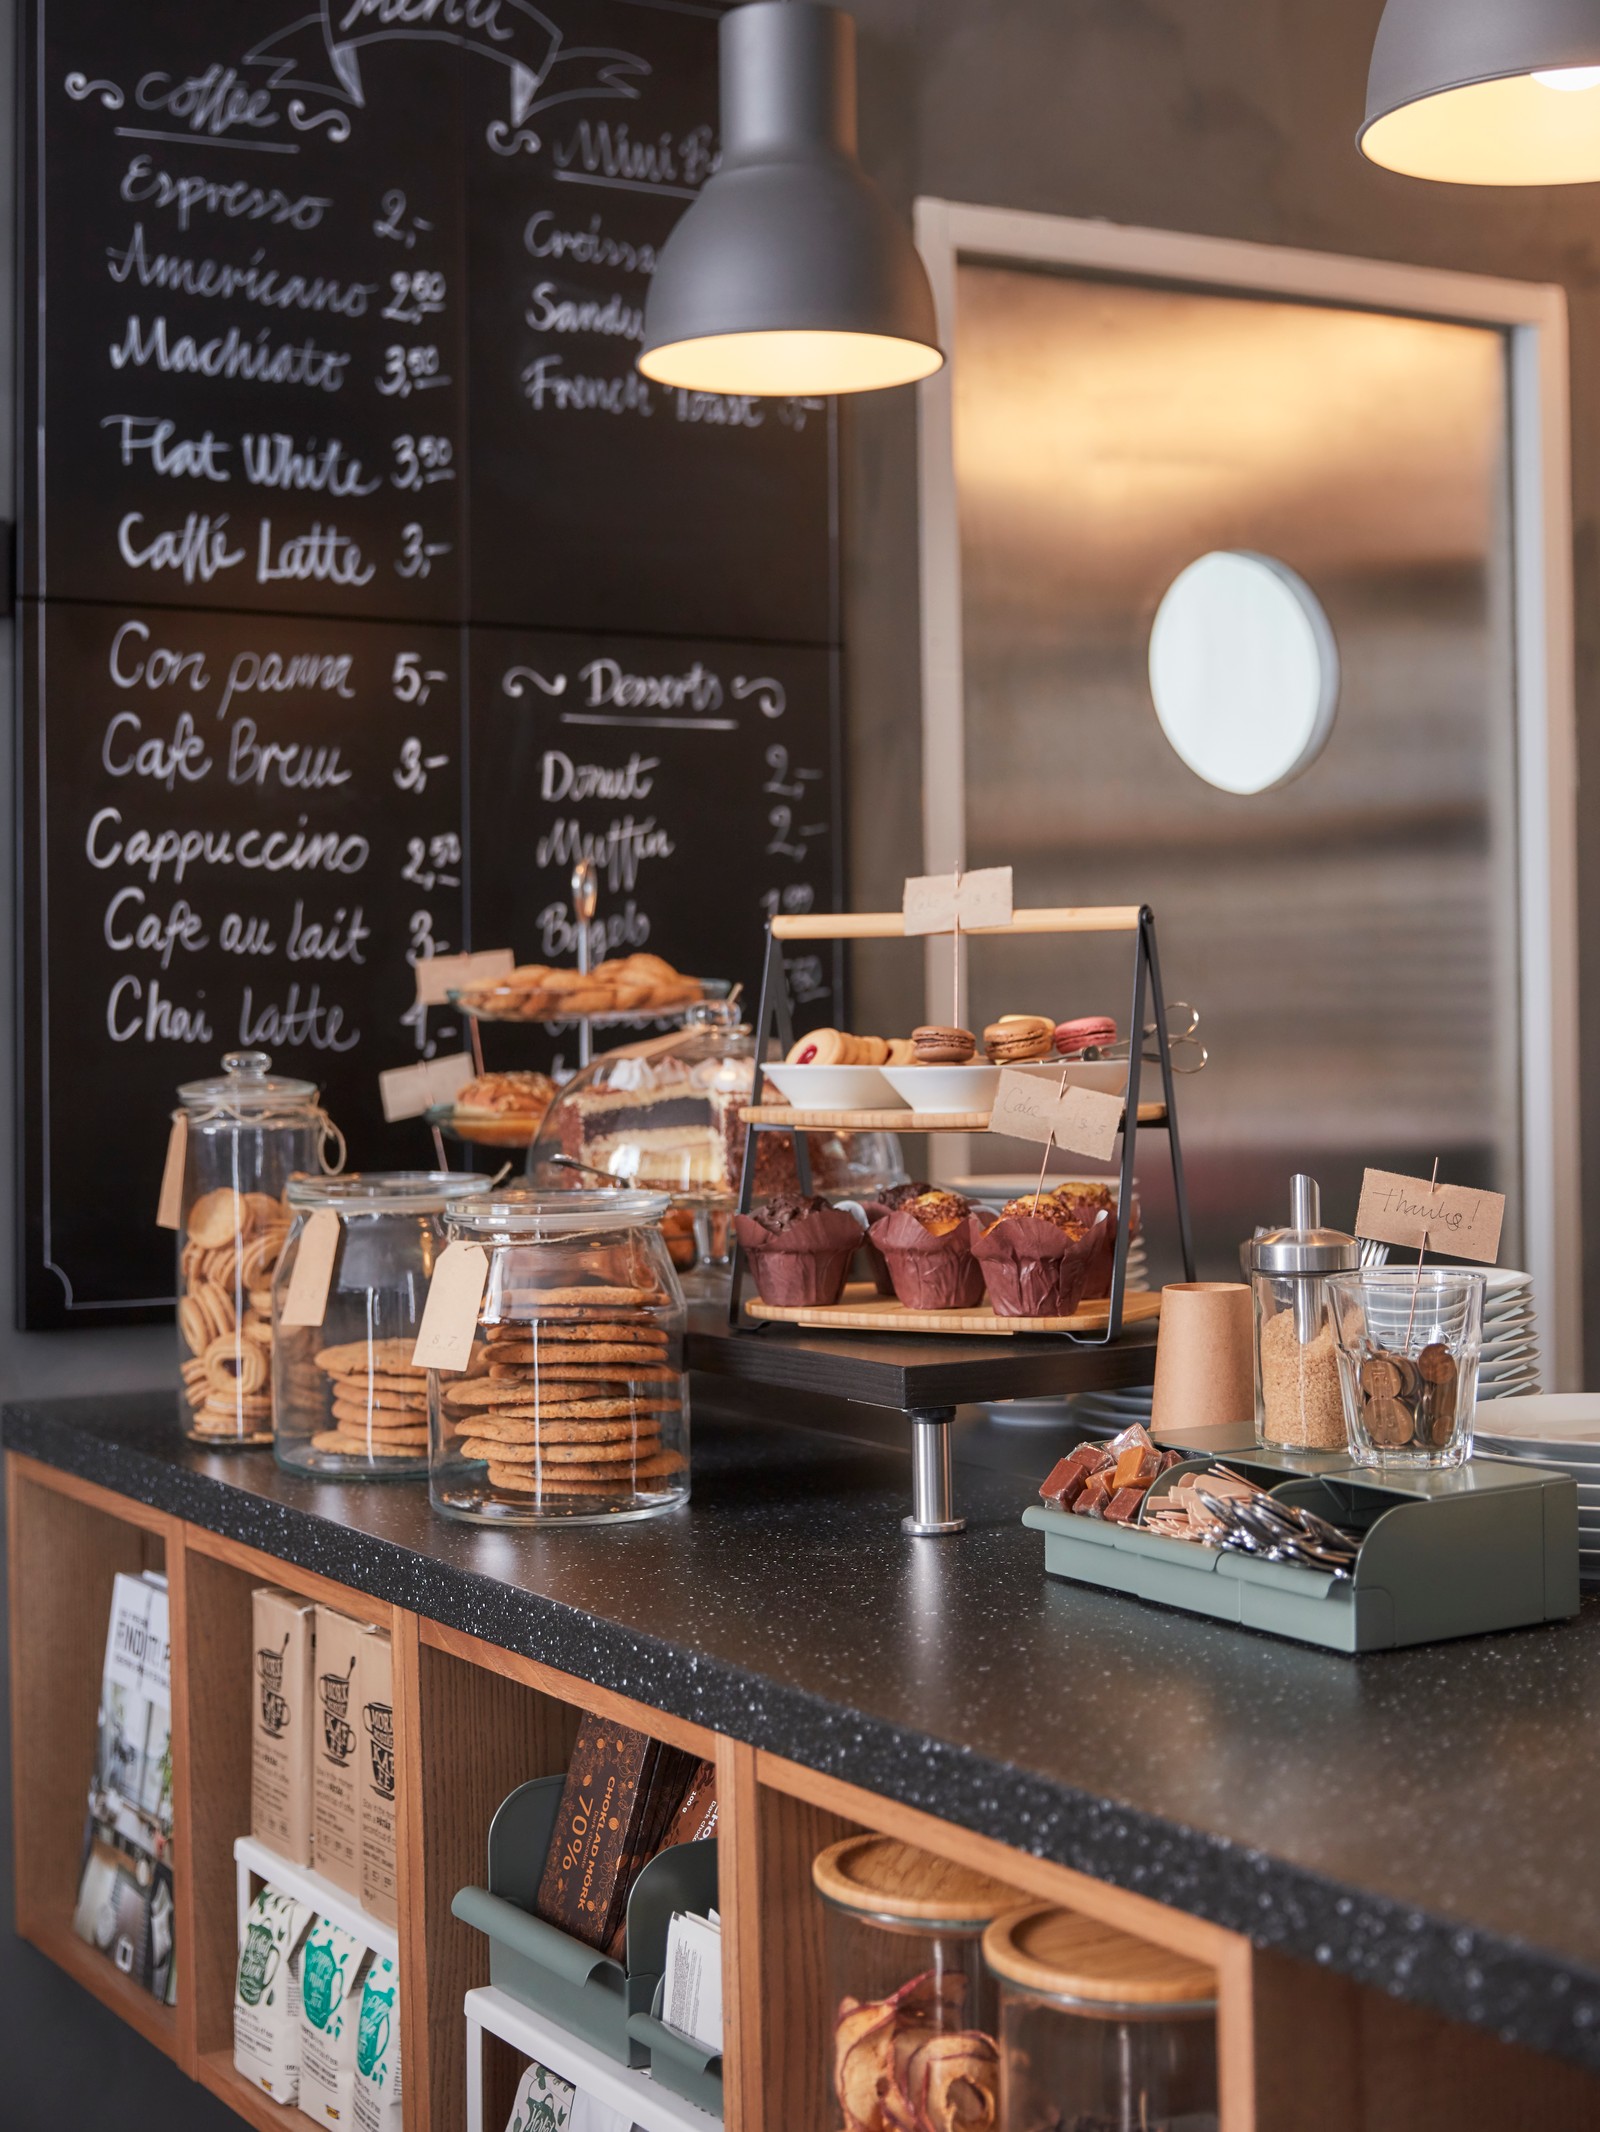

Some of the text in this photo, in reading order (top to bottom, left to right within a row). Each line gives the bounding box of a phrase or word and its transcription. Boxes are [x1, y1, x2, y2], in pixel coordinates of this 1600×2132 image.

[119, 153, 334, 232] Espresso
[105, 222, 380, 317] Americano
[525, 281, 646, 342] Sandw
[100, 413, 233, 482] Flat
[241, 432, 383, 498] White
[256, 516, 377, 587] Latte
[108, 619, 211, 692] Con
[215, 648, 357, 722] panna
[541, 749, 662, 802] Donut
[85, 806, 371, 885] Cappuccino
[218, 912, 277, 957] au
[284, 898, 372, 965] lait
[106, 974, 214, 1044] Chai
[562, 1795, 595, 1871] 70%
[687, 1790, 697, 1806] 100
[704, 1800, 717, 1819] Dark
[577, 1776, 616, 1911] CHOKLAD MÖRK
[581, 1810, 600, 1870] Dark chocolate
